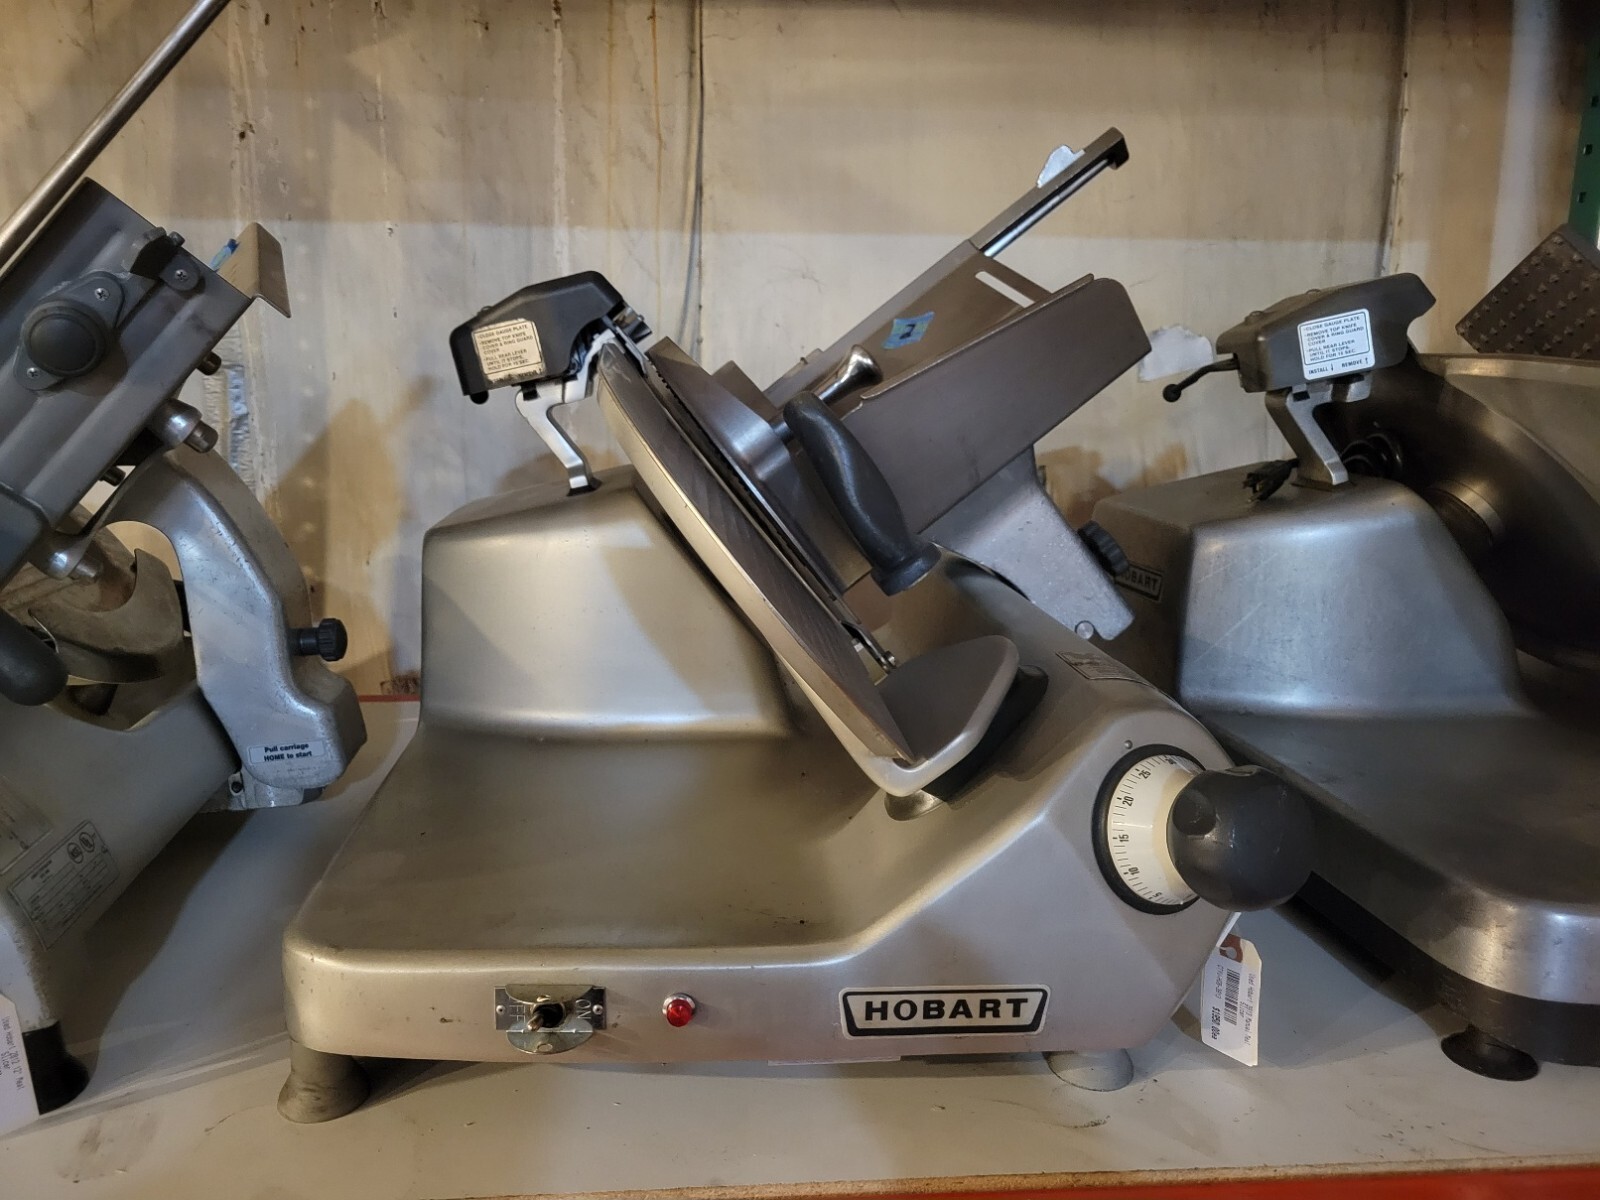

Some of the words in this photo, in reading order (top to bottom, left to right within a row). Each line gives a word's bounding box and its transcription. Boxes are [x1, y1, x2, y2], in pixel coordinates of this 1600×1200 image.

[1307, 329, 1328, 337] REMOVE
[1346, 326, 1364, 334] GUARD
[1309, 366, 1329, 375] INSTALL
[1342, 359, 1362, 368] REMOVE
[264, 745, 278, 753] Pull
[280, 743, 309, 752] carriage
[264, 753, 285, 762] HOME
[1139, 770, 1151, 779] 25
[1122, 796, 1134, 806] 20
[1119, 834, 1129, 842] 15
[1128, 866, 1140, 875] 10
[575, 999, 592, 1019] ON
[864, 997, 1029, 1021] HOBART
